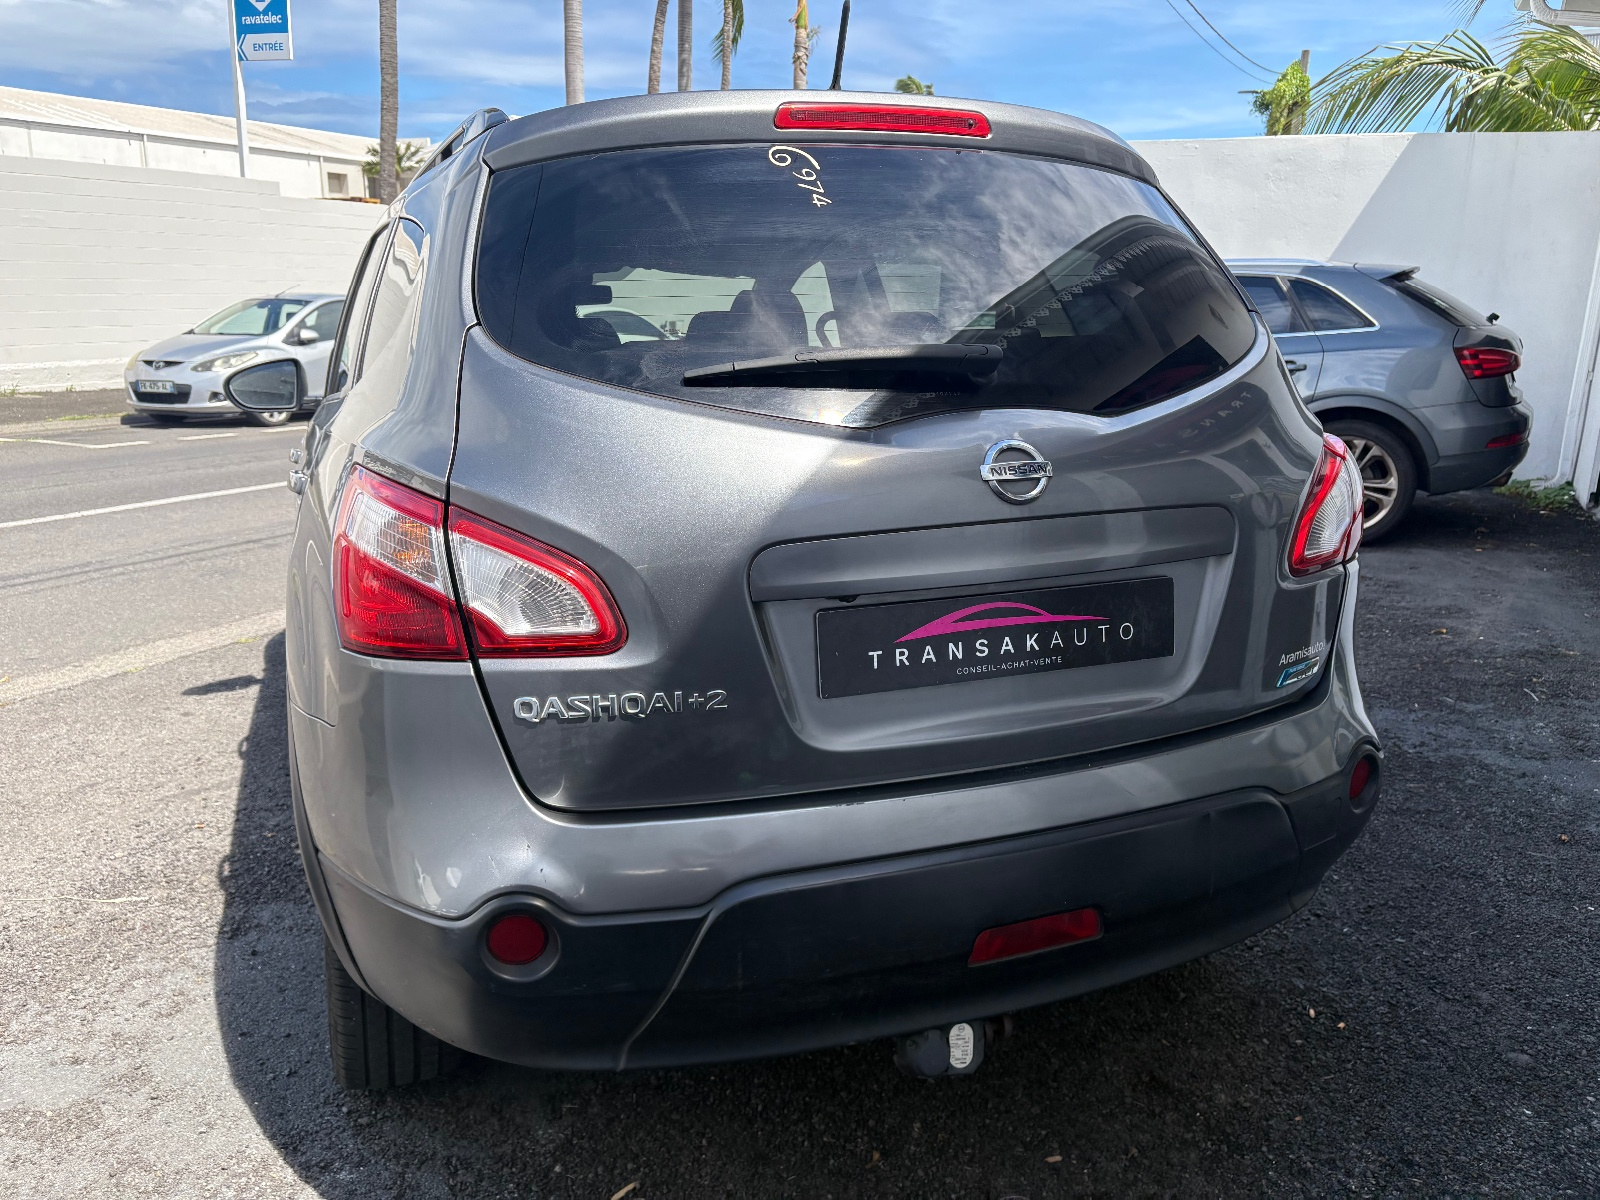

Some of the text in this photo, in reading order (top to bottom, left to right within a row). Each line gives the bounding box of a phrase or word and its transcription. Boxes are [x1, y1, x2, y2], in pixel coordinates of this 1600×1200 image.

[241, 12, 282, 25] ravatelec
[252, 40, 284, 52] ENTRÉE
[989, 464, 1048, 477] NISSAN
[956, 655, 1063, 675] CONSEIL-ACHAT-VENTE
